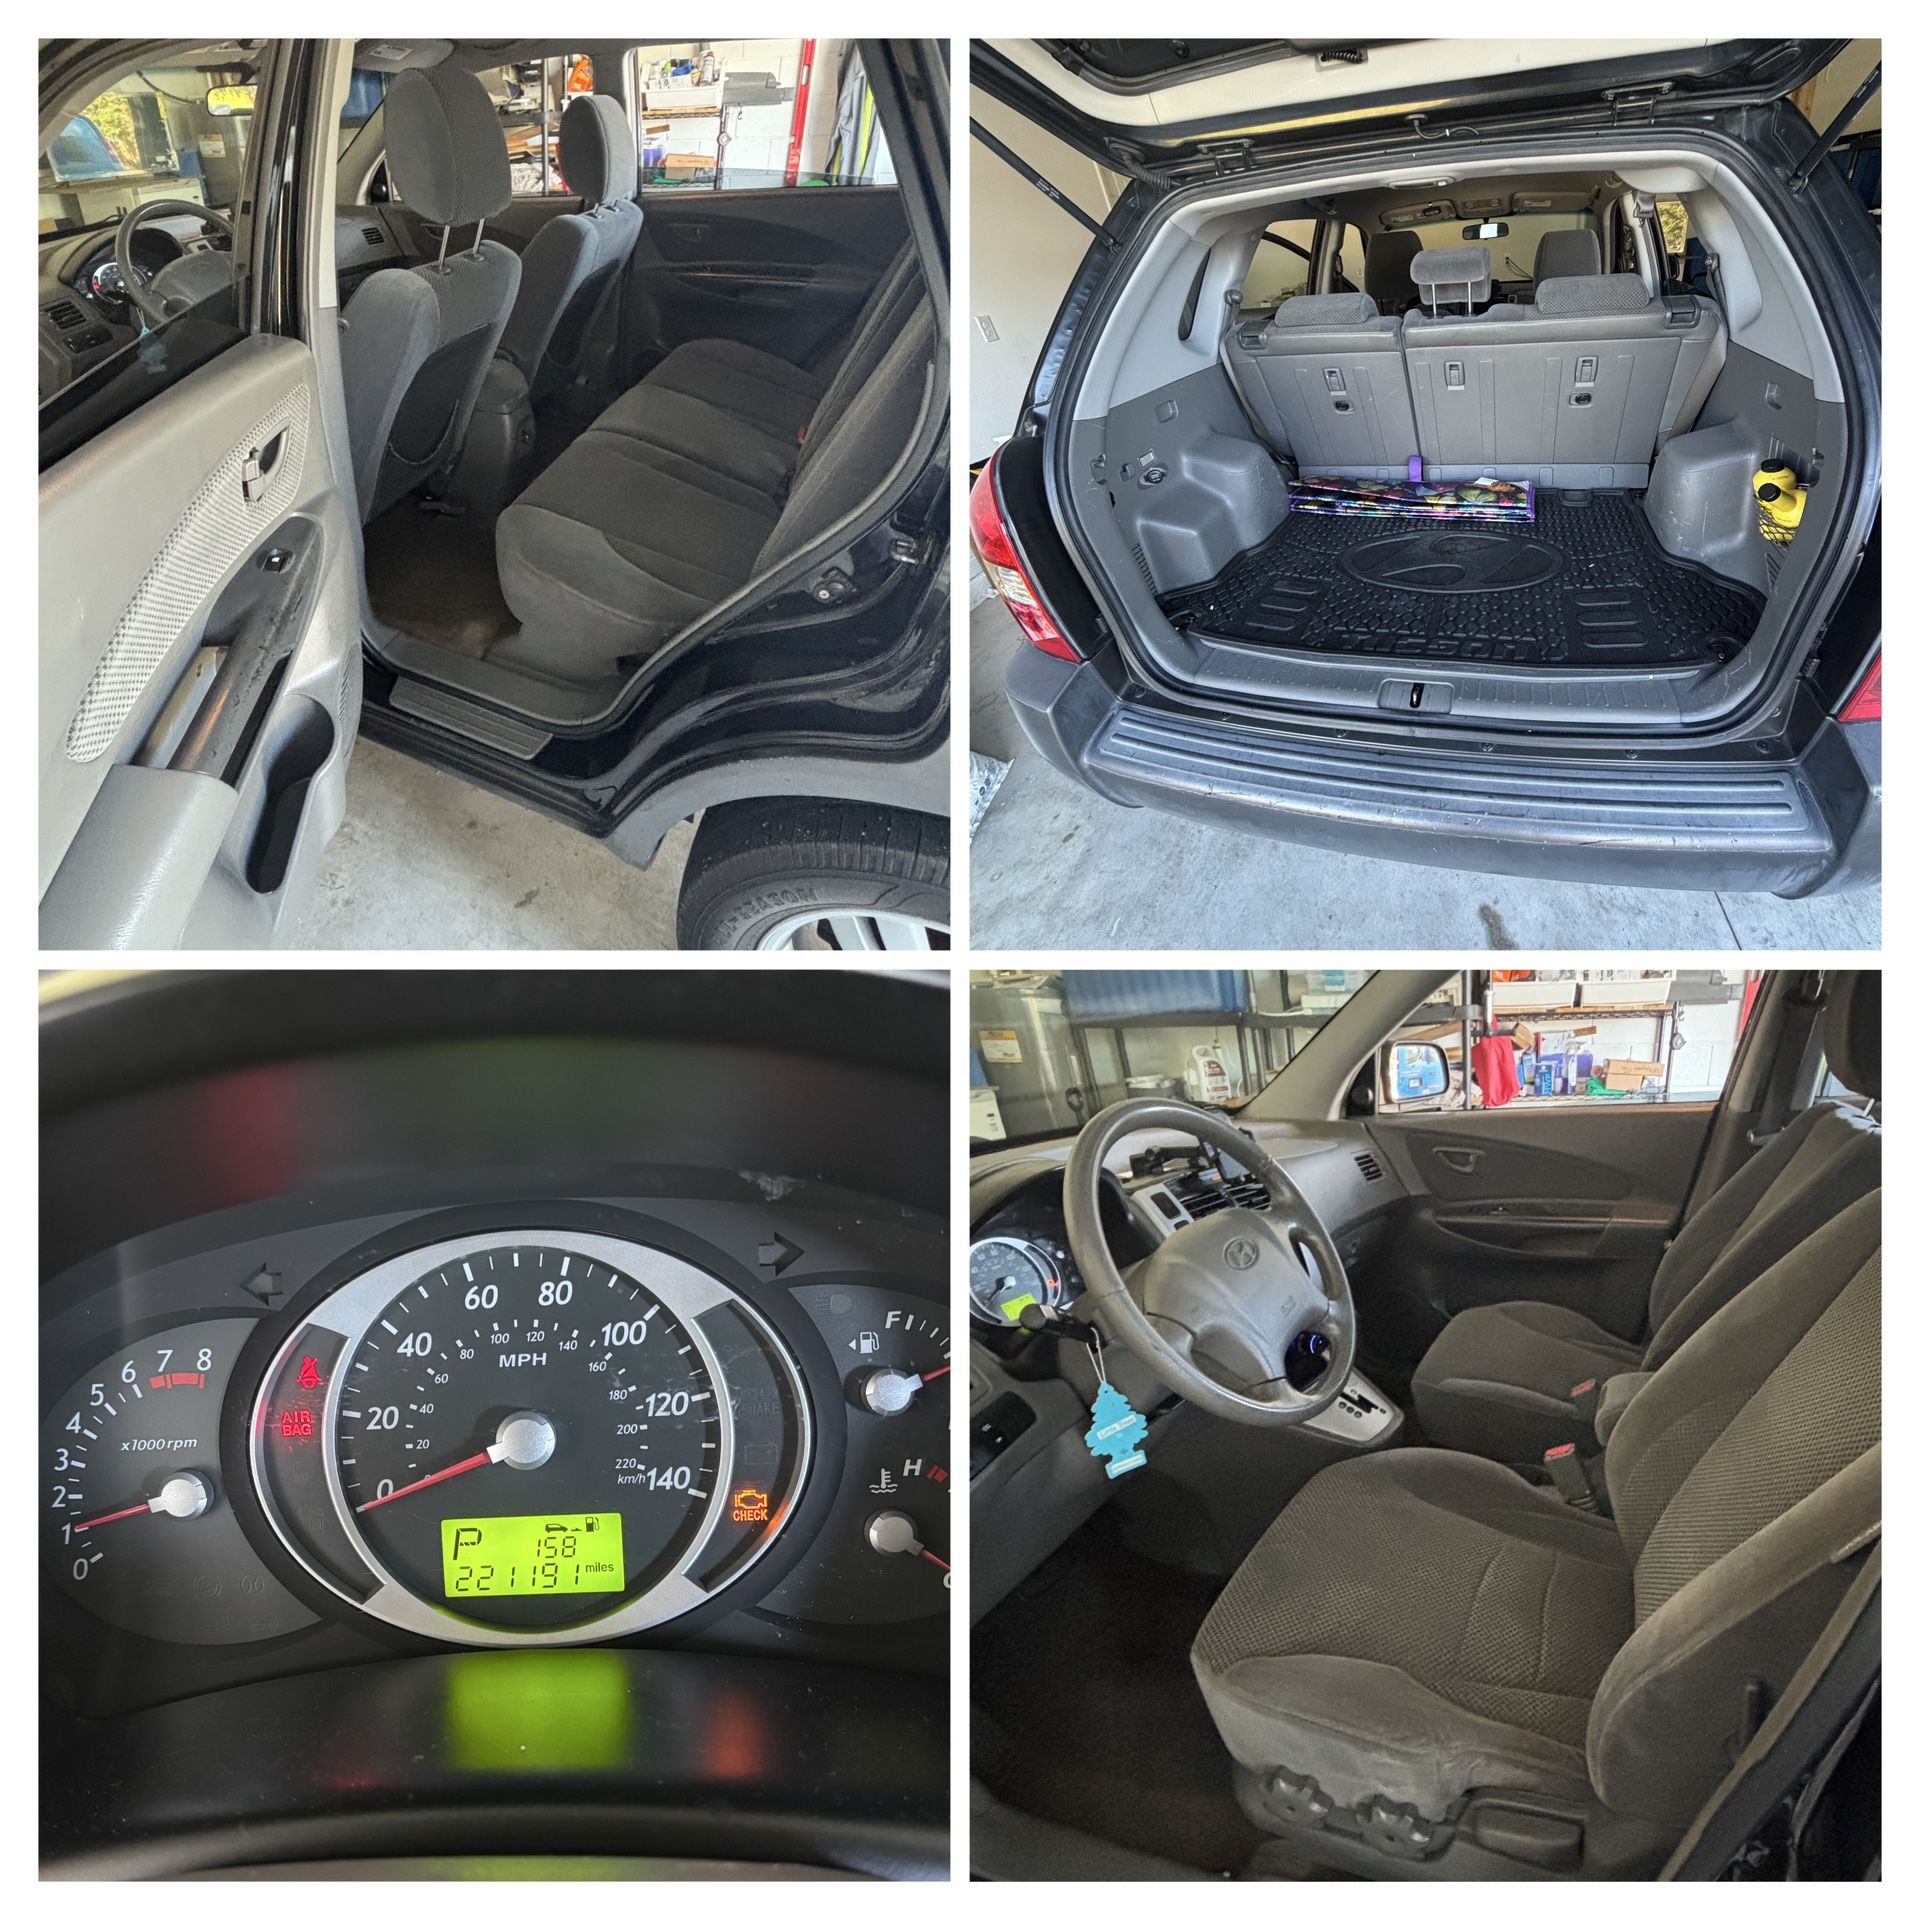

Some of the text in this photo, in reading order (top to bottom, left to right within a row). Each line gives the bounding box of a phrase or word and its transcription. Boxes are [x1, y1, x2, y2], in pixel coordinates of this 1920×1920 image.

[464, 1284, 499, 1310] 60
[538, 1280, 573, 1306] 80
[885, 1310, 901, 1329] F
[490, 1333, 510, 1345] 100
[526, 1330, 545, 1343] 120
[601, 1320, 647, 1346] 100
[397, 1332, 433, 1357] 40
[459, 1348, 475, 1360] 80
[558, 1340, 578, 1352] 140
[157, 1349, 173, 1372] 7
[196, 1348, 212, 1371] 8
[499, 1352, 547, 1368] MPH
[588, 1360, 607, 1372] 160
[121, 1360, 137, 1383] 6
[434, 1373, 449, 1385] 60
[90, 1383, 105, 1406] 5
[608, 1389, 628, 1401] 180
[646, 1391, 690, 1417] 120
[282, 1410, 311, 1423] AIR
[366, 1406, 399, 1431] 20
[419, 1403, 434, 1415] 40
[65, 1411, 81, 1434] 4
[282, 1424, 312, 1436] BAG
[616, 1423, 638, 1435] 200
[416, 1438, 430, 1450] 20
[54, 1448, 69, 1471] 3
[615, 1457, 637, 1469] 220
[903, 1458, 923, 1477] H
[617, 1473, 646, 1485] km/h
[646, 1466, 691, 1490] 140
[51, 1485, 66, 1508] 2
[376, 1478, 394, 1501] 0
[732, 1509, 768, 1521] CHECK
[61, 1523, 71, 1544] 1
[453, 1528, 482, 1560] P
[537, 1536, 576, 1558] 158
[73, 1559, 88, 1581] 0
[455, 1563, 580, 1591] 221191
[585, 1562, 614, 1573] miles
